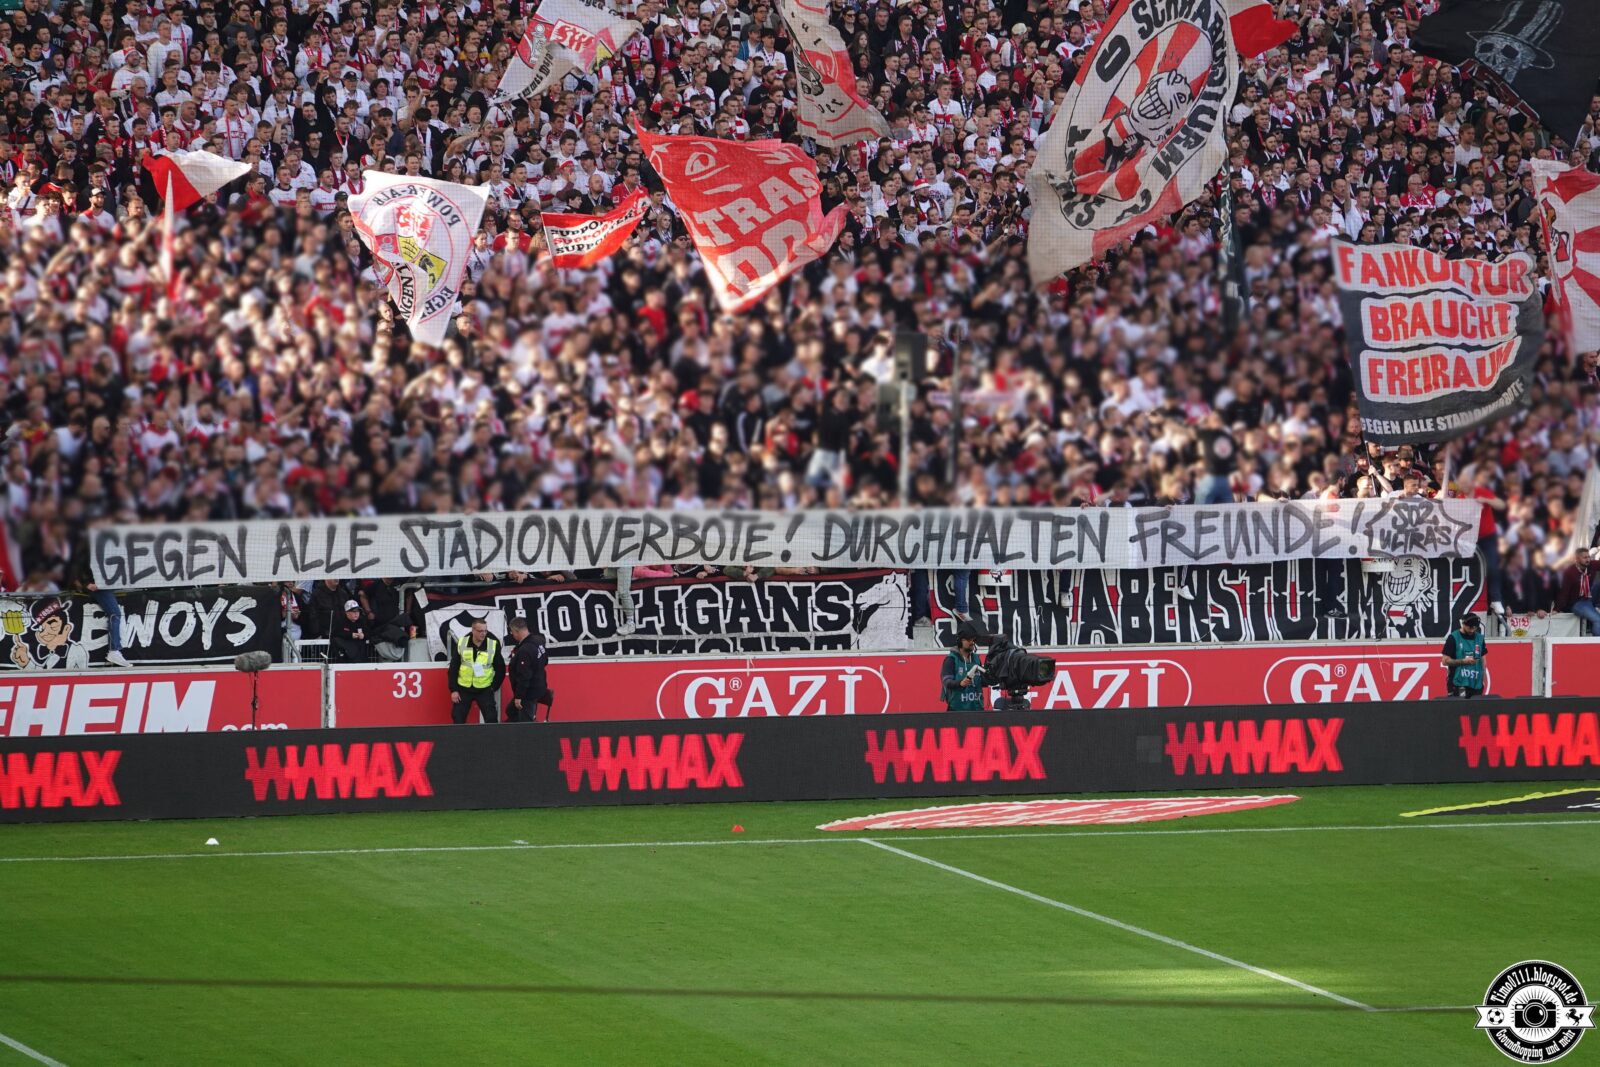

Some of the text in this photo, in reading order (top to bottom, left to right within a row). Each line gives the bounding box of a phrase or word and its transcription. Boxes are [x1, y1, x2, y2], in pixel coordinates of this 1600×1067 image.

[1336, 245, 1529, 296] FANKULTUR
[1369, 298, 1512, 342] BRAUCHT
[1403, 418, 1435, 434] ALLE
[97, 500, 1365, 585] GEGEN ALLE STADIONVERBOTE! DURCHHALTEN FREUNDE!
[1380, 525, 1452, 553] ULTRAS
[392, 671, 422, 698] 33
[1290, 661, 1450, 705] GAZ
[0, 680, 216, 737] HEIM
